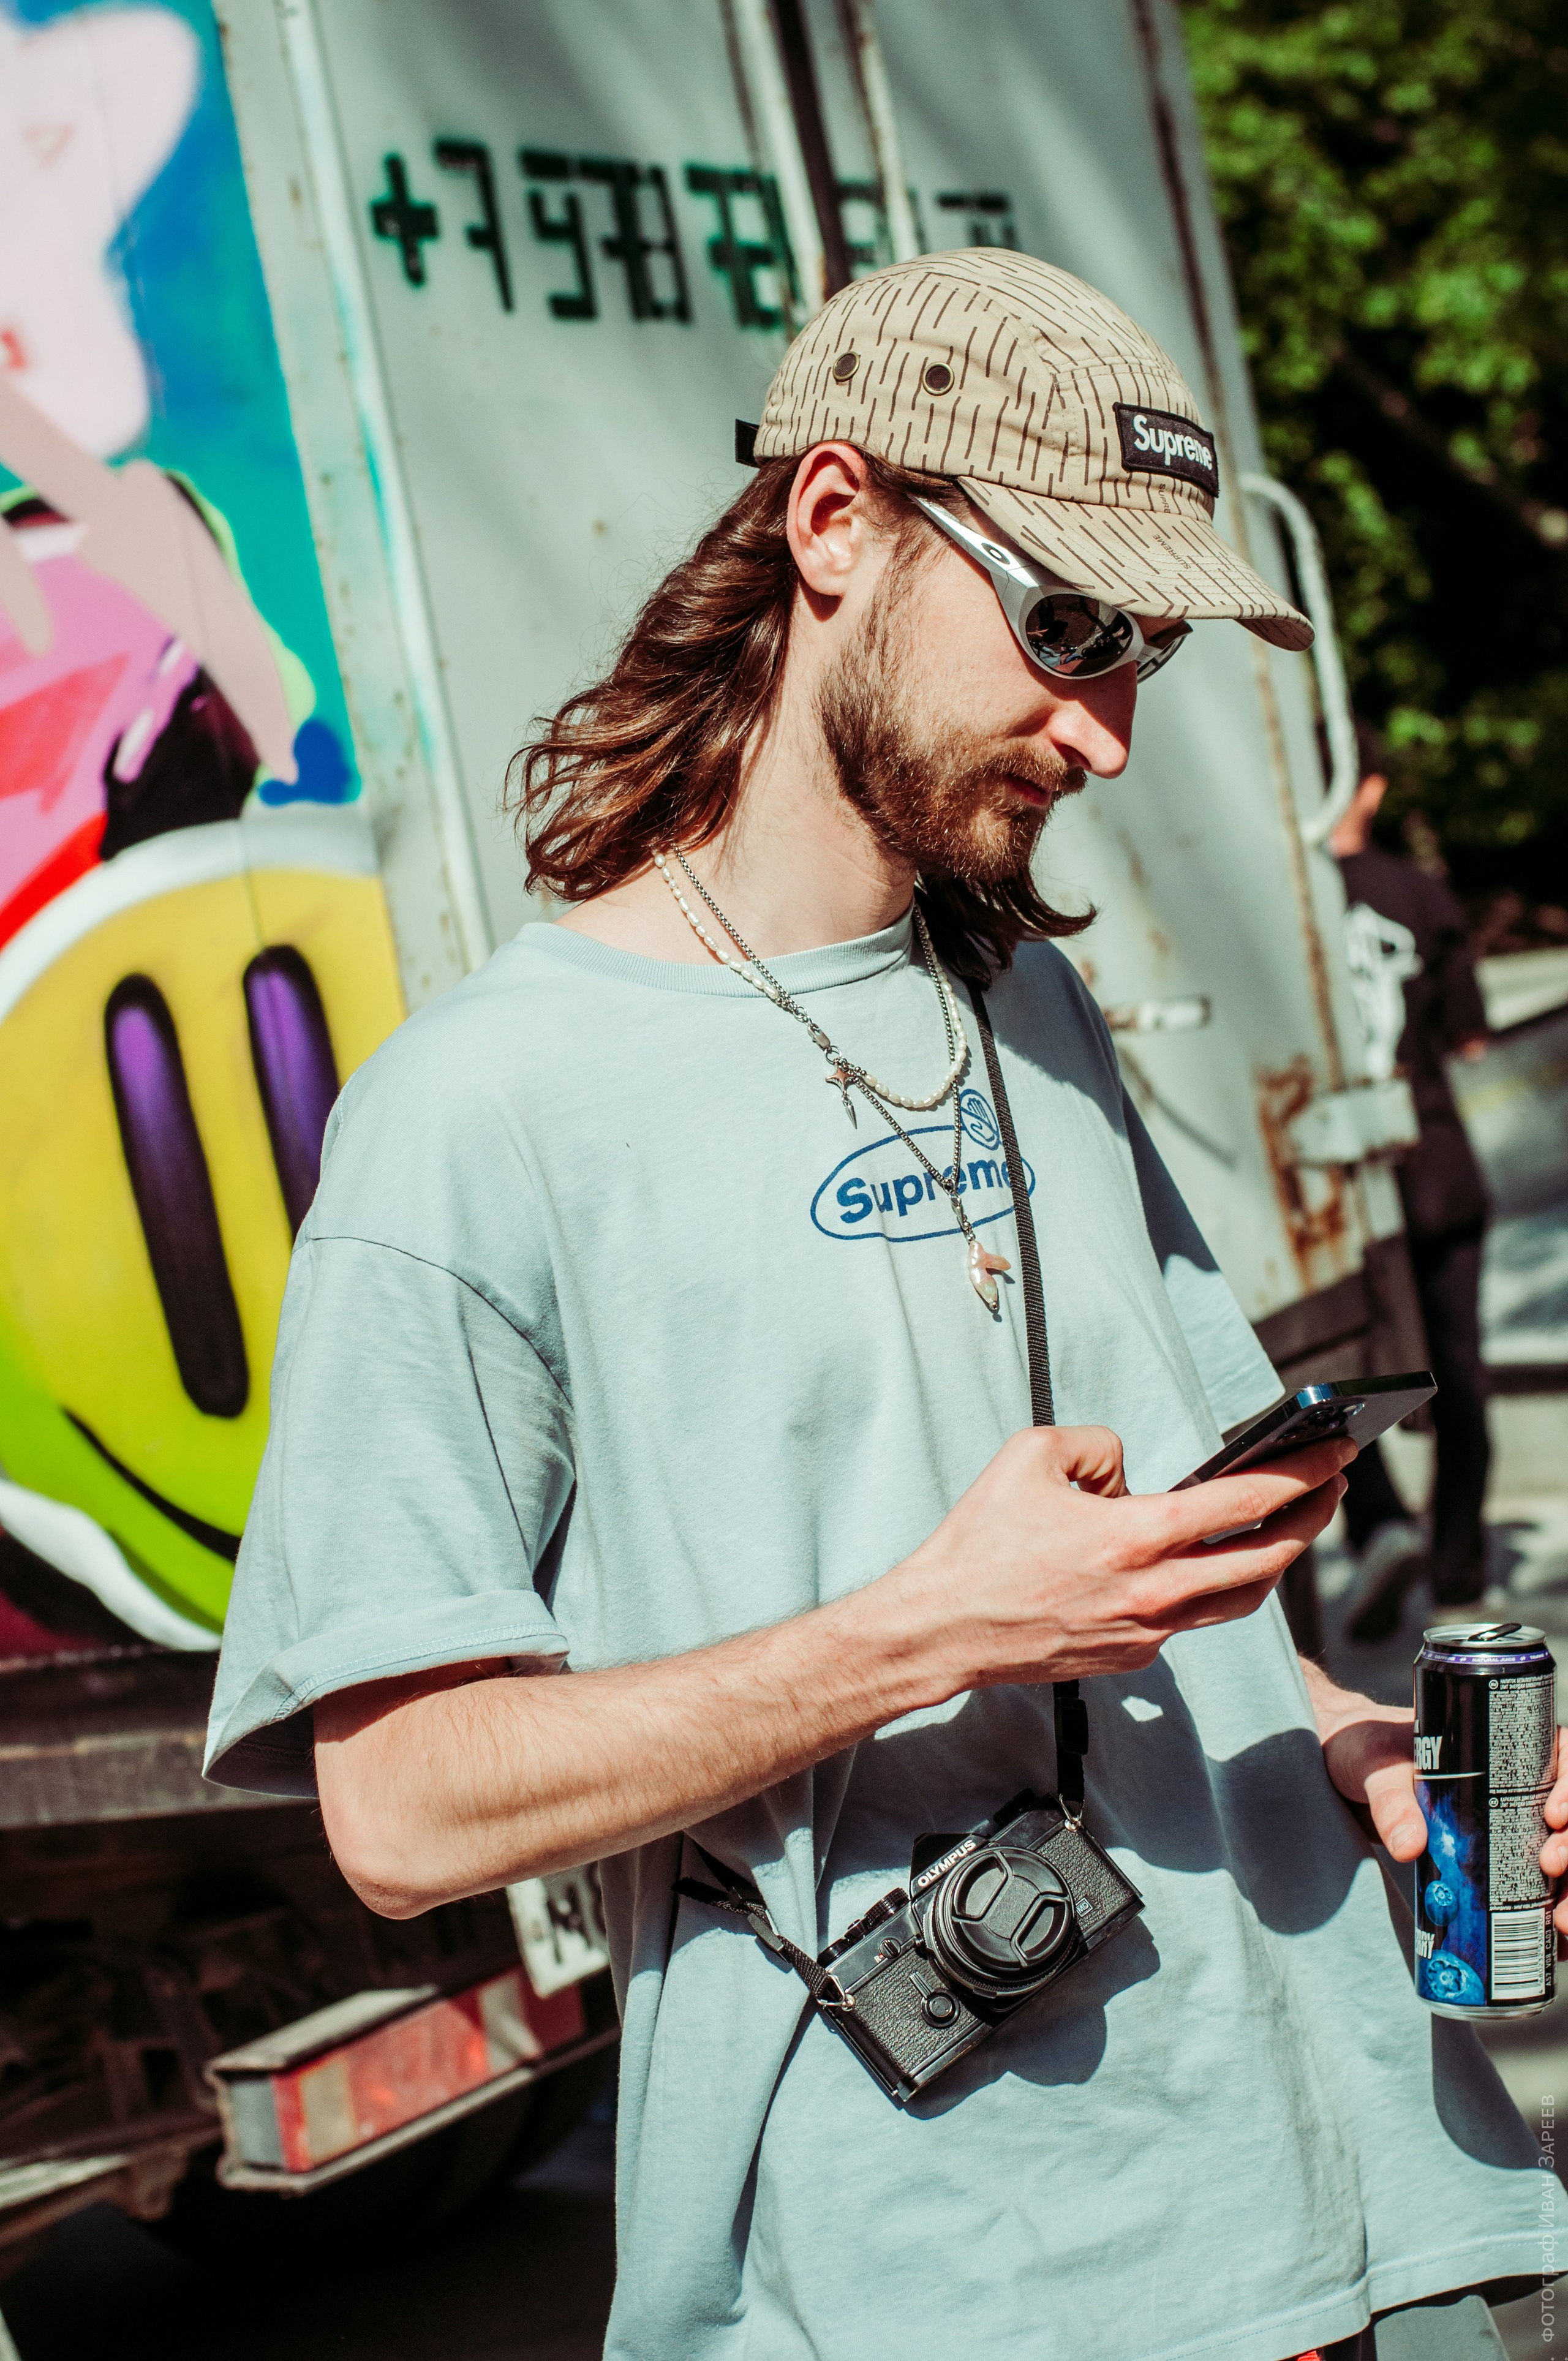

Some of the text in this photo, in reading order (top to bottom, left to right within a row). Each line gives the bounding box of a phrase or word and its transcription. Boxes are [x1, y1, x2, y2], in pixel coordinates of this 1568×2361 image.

[1133, 415, 1213, 470] Supreme
[1152, 534, 1191, 569] SUPREME
[918, 1839, 976, 1887] OLYMPUS
[1076, 1902, 1089, 1914] MD
